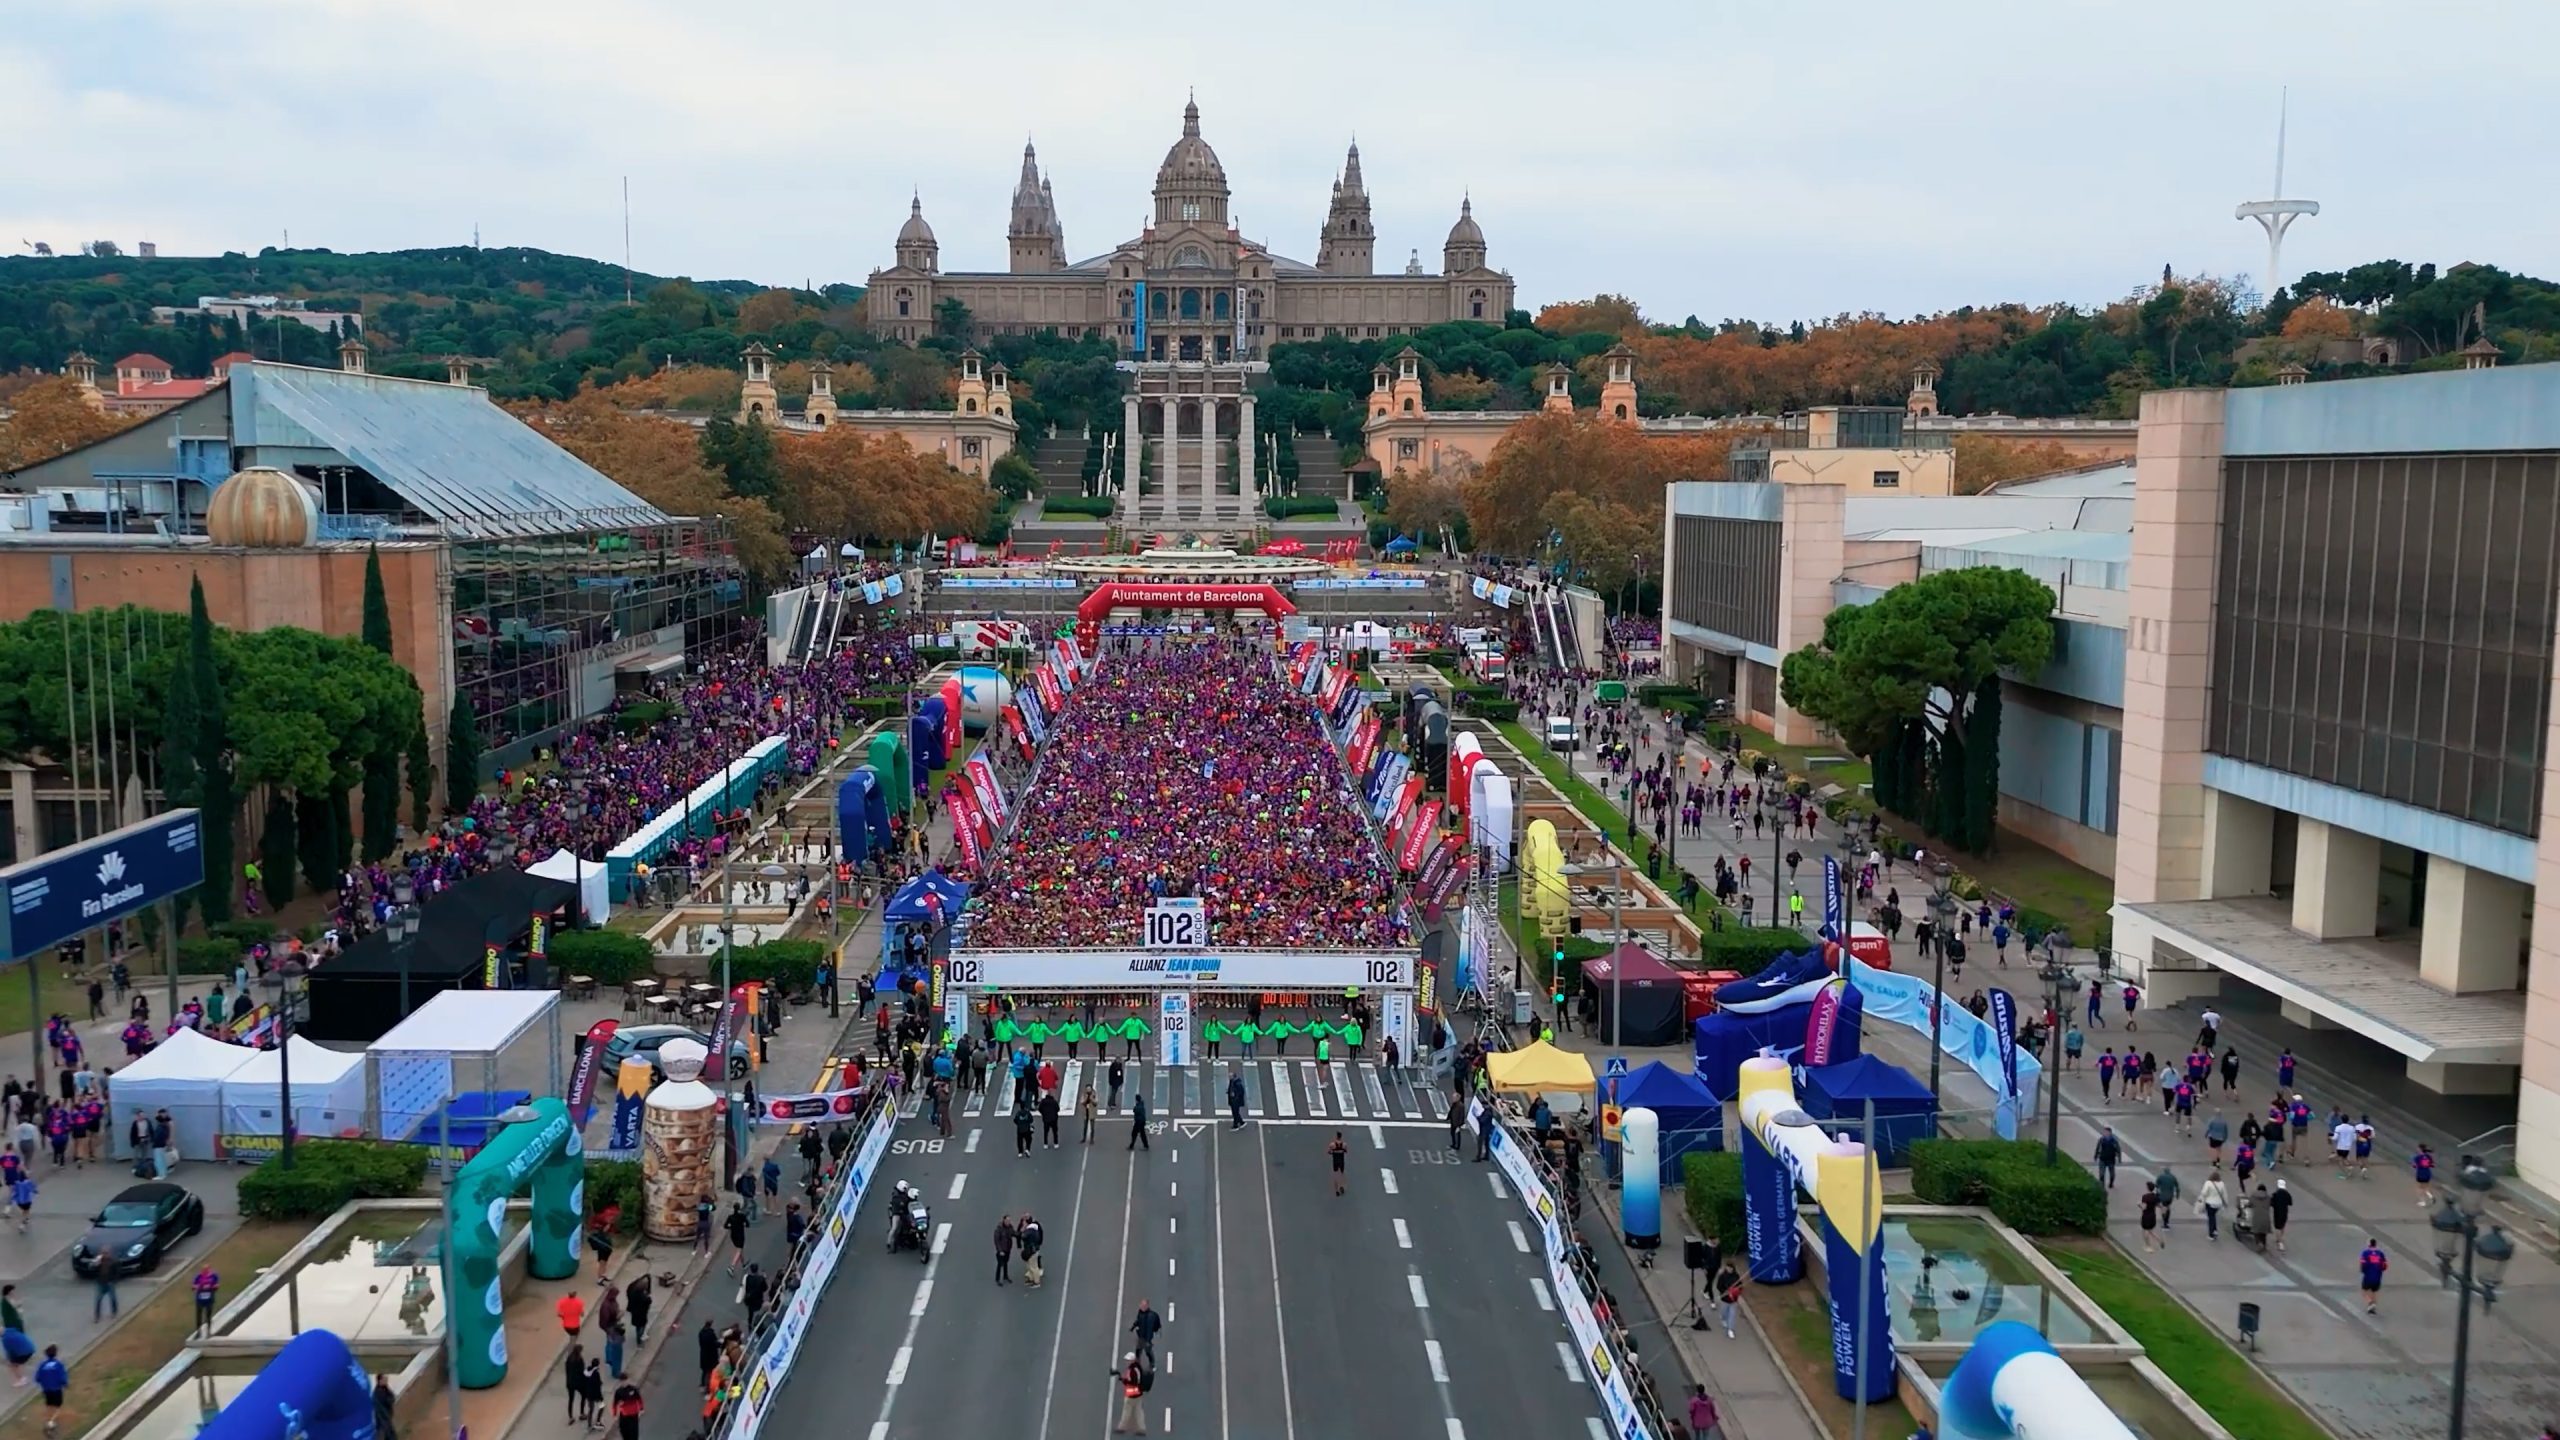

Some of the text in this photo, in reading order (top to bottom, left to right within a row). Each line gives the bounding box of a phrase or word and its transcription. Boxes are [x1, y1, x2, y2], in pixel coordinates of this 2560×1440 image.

[1111, 589, 1264, 602] Ajuntament de Barcelona
[1411, 807, 1434, 854] nutrisport
[1421, 846, 1446, 883] BARCELONA
[1433, 867, 1459, 905] BARCELONA
[1147, 912, 1193, 945] 102
[1195, 912, 1203, 945] EDICIÓ
[1129, 958, 1221, 971] ALLIANZ JEAN BOUIN
[1365, 960, 1398, 983] 102
[932, 964, 942, 1007] MUNDO
[1420, 965, 1431, 1008] MUNDO
[1163, 1016, 1184, 1031] 102
[571, 1045, 594, 1105] BARCELONA
[625, 1106, 639, 1147] VARTA
[891, 1138, 945, 1154] BUS
[1408, 1149, 1461, 1165] BUS
[1777, 1169, 1786, 1220] GERMANY
[1752, 1212, 1762, 1260] POWER
[1841, 1321, 1856, 1377] POWER
